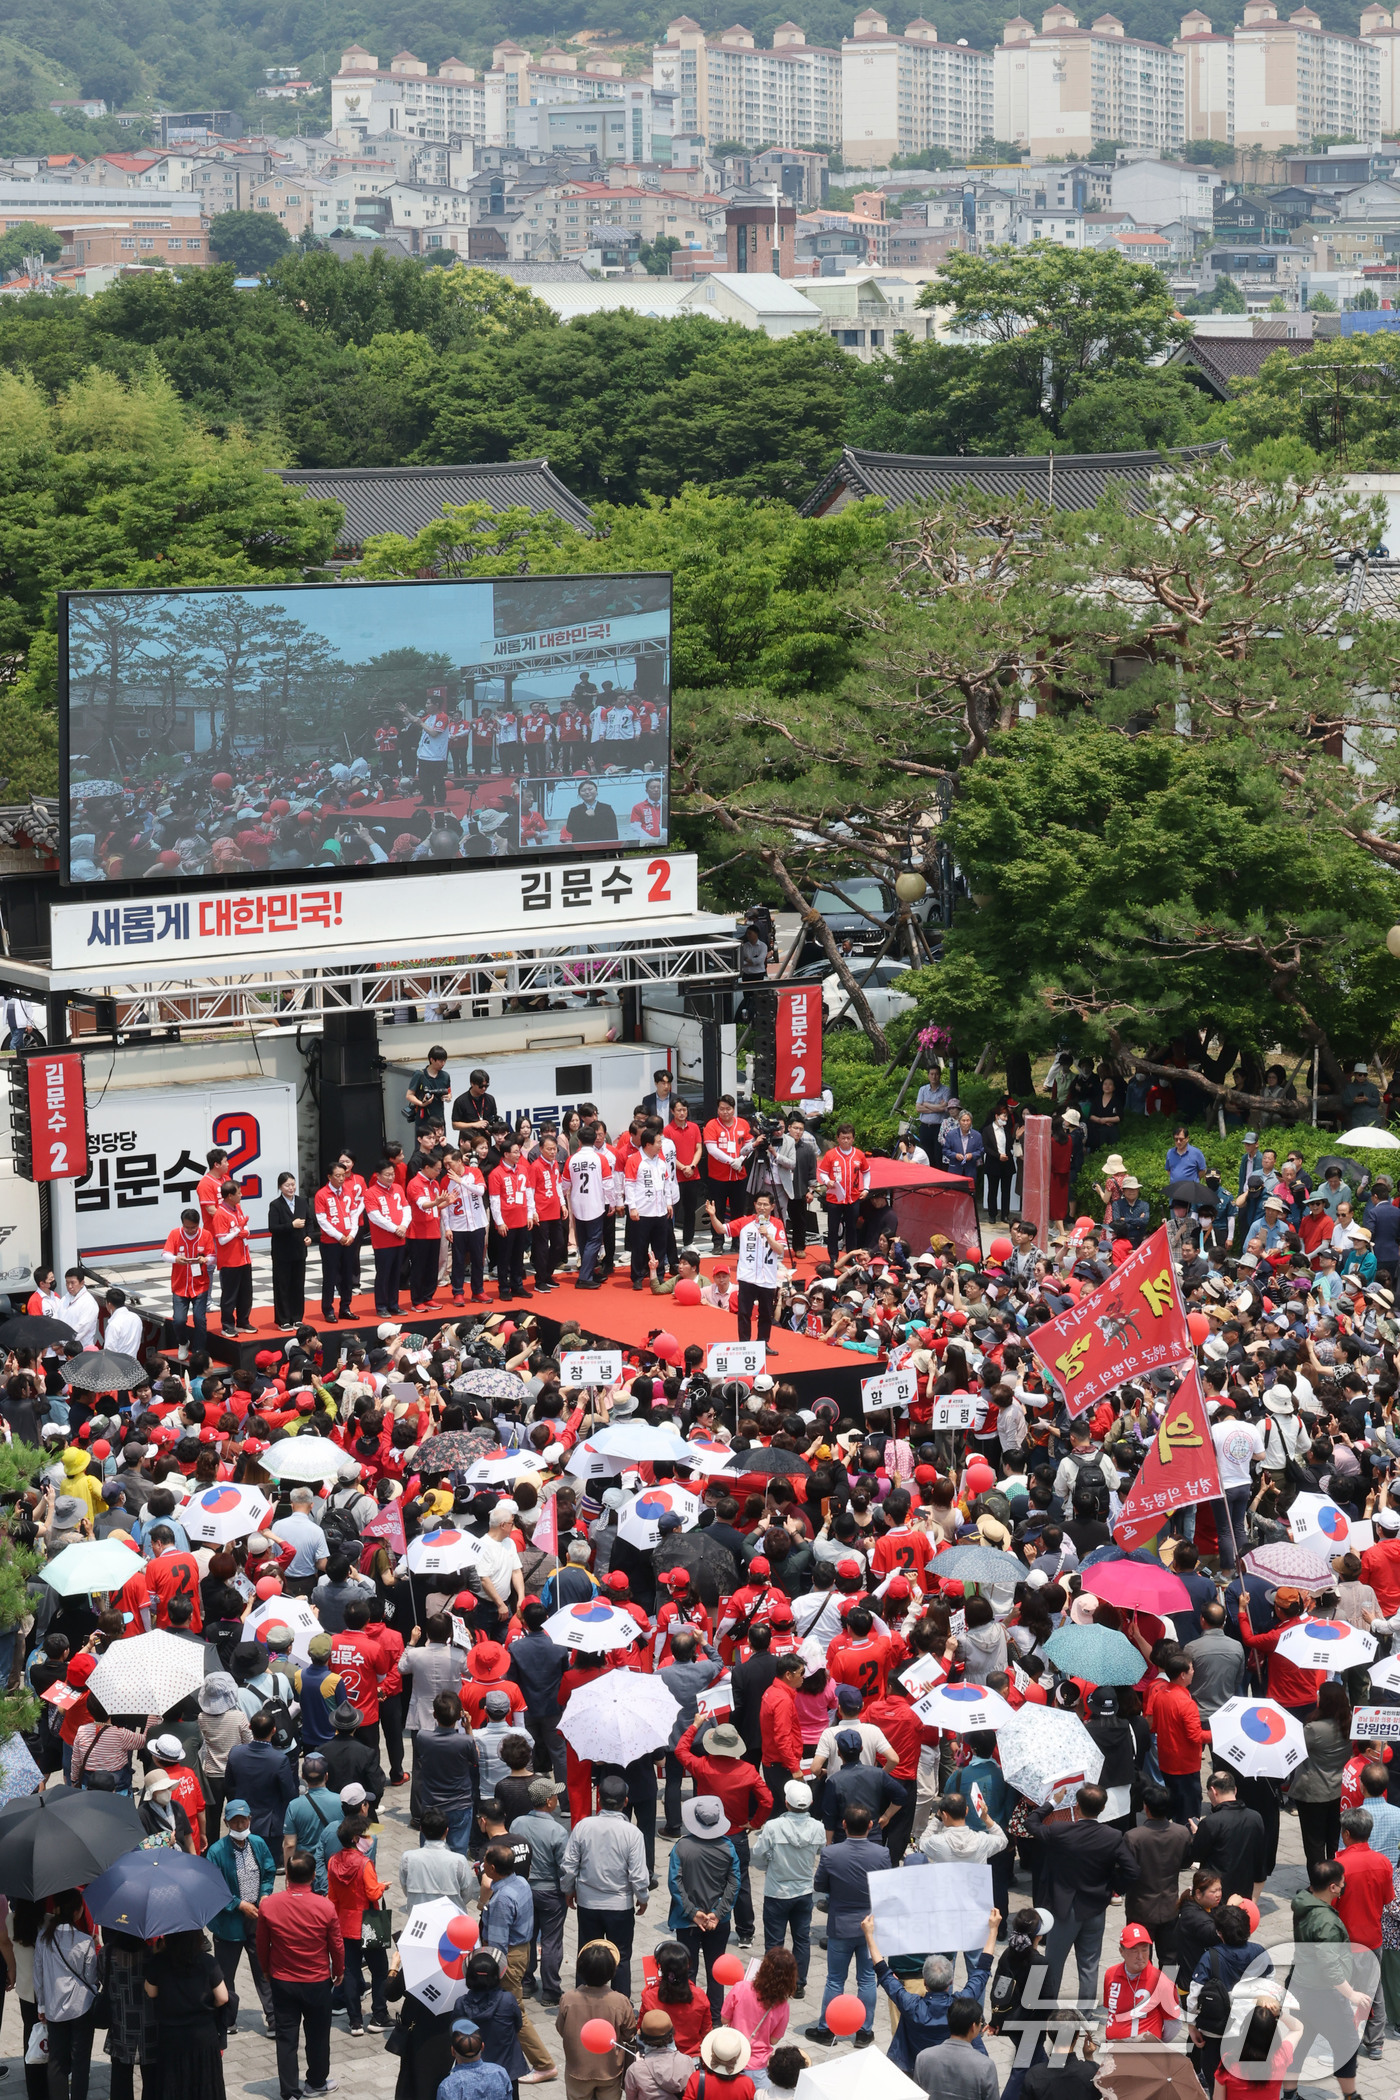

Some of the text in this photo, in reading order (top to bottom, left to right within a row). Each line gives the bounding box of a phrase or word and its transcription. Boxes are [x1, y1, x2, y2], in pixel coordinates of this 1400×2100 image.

[493, 623, 611, 657] 새롭게 대한민국!
[621, 716, 629, 729] 2
[521, 859, 672, 911] 김문수 2
[87, 891, 343, 946] 새롭게 대한민국!
[790, 993, 808, 1094] 김문수 2
[45, 1063, 69, 1173] 김문수 2
[74, 1111, 263, 1213] 김문수 2
[571, 1161, 597, 1173] 김문수
[353, 1183, 361, 1201] 2
[503, 1173, 527, 1205] 김문수 2
[542, 1170, 553, 1198] 김문수
[579, 1172, 589, 1194] 2
[642, 1169, 654, 1199] 김문수
[326, 1195, 352, 1226] 김문수 2
[393, 1193, 403, 1211] 2
[453, 1198, 464, 1216] 2
[1074, 1227, 1083, 1238] 2
[746, 1231, 757, 1264] 김문수
[812, 1317, 817, 1330] 2
[570, 1365, 612, 1381] 창 녕
[716, 1356, 757, 1372] 밀 양
[870, 1390, 883, 1406] 함
[897, 1384, 909, 1399] 안
[939, 1408, 970, 1424] 의 령
[171, 1563, 194, 1598] 2
[331, 1650, 364, 1667] 김문수
[338, 1668, 362, 1702] 2
[859, 1660, 880, 1696] 2
[904, 1678, 918, 1693] 2
[698, 1700, 708, 1715] 2
[510, 1843, 530, 1855] REA
[1132, 1928, 1141, 1938] 2
[1107, 1982, 1151, 2028] 김문수 2
